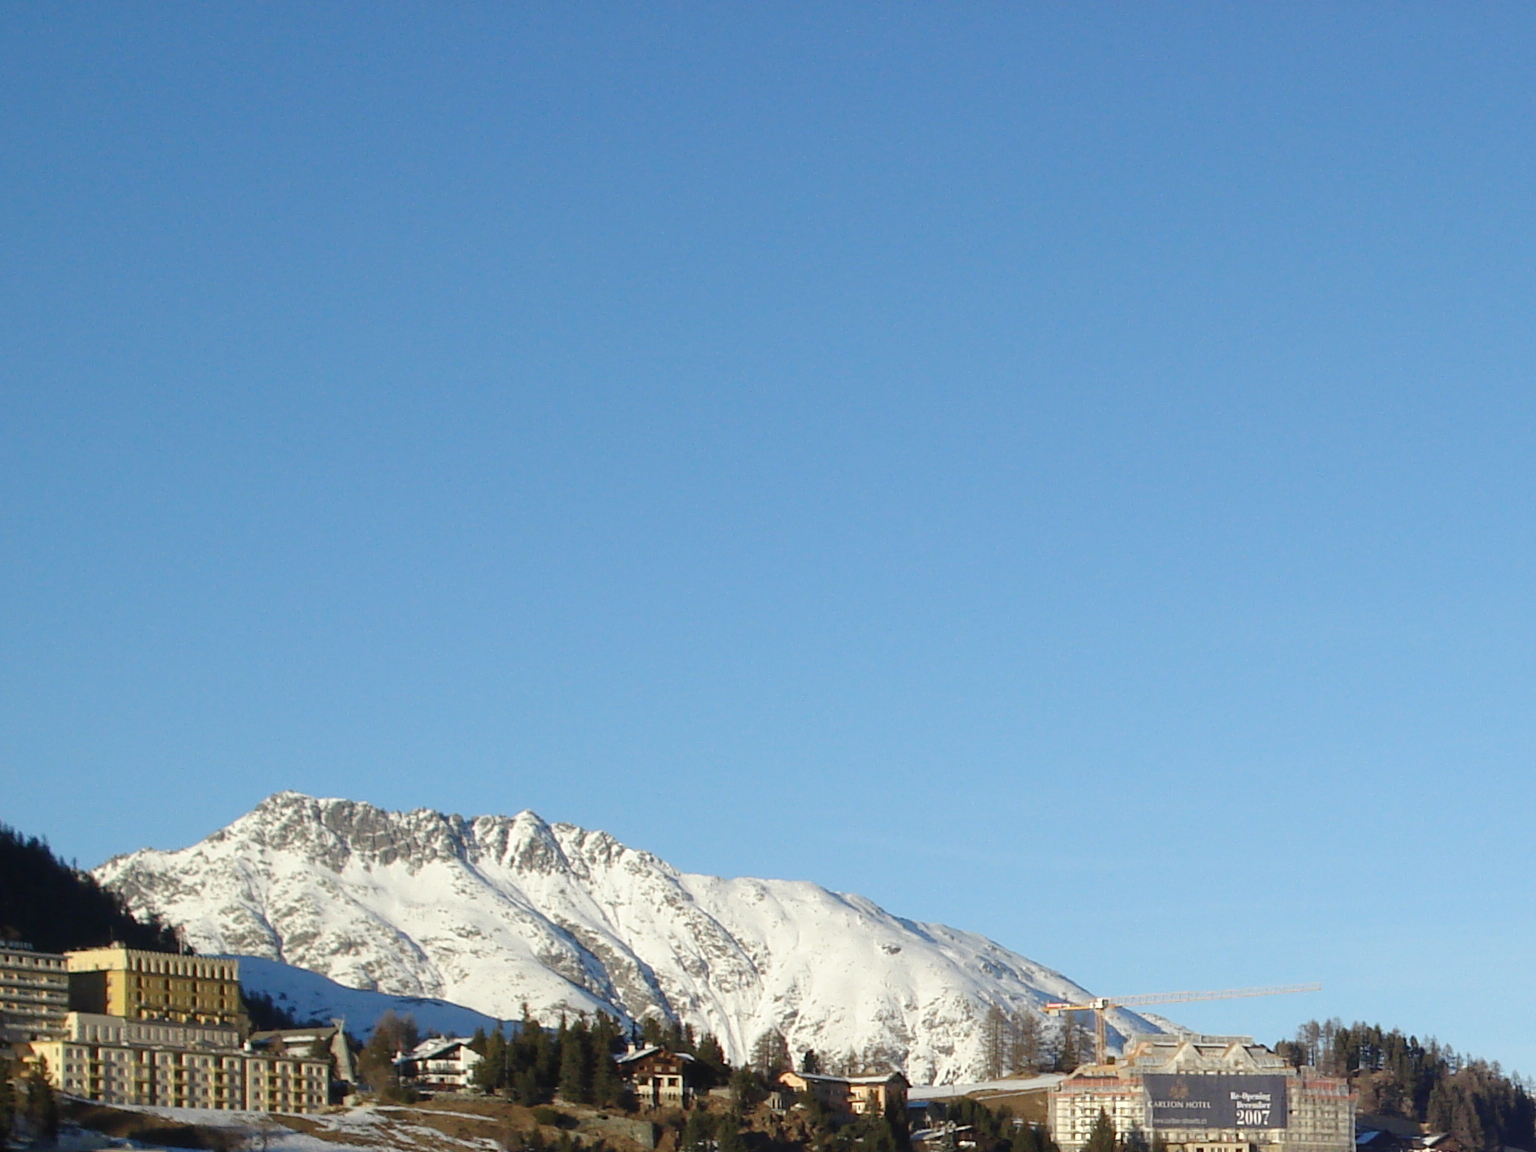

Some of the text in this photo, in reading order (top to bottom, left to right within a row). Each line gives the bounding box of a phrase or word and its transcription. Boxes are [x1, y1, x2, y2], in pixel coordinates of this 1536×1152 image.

[1230, 1092, 1271, 1102] Re-Opening
[1147, 1101, 1212, 1109] CARLTON HOTEL
[1236, 1101, 1271, 1109] December
[1236, 1110, 1271, 1125] 2007
